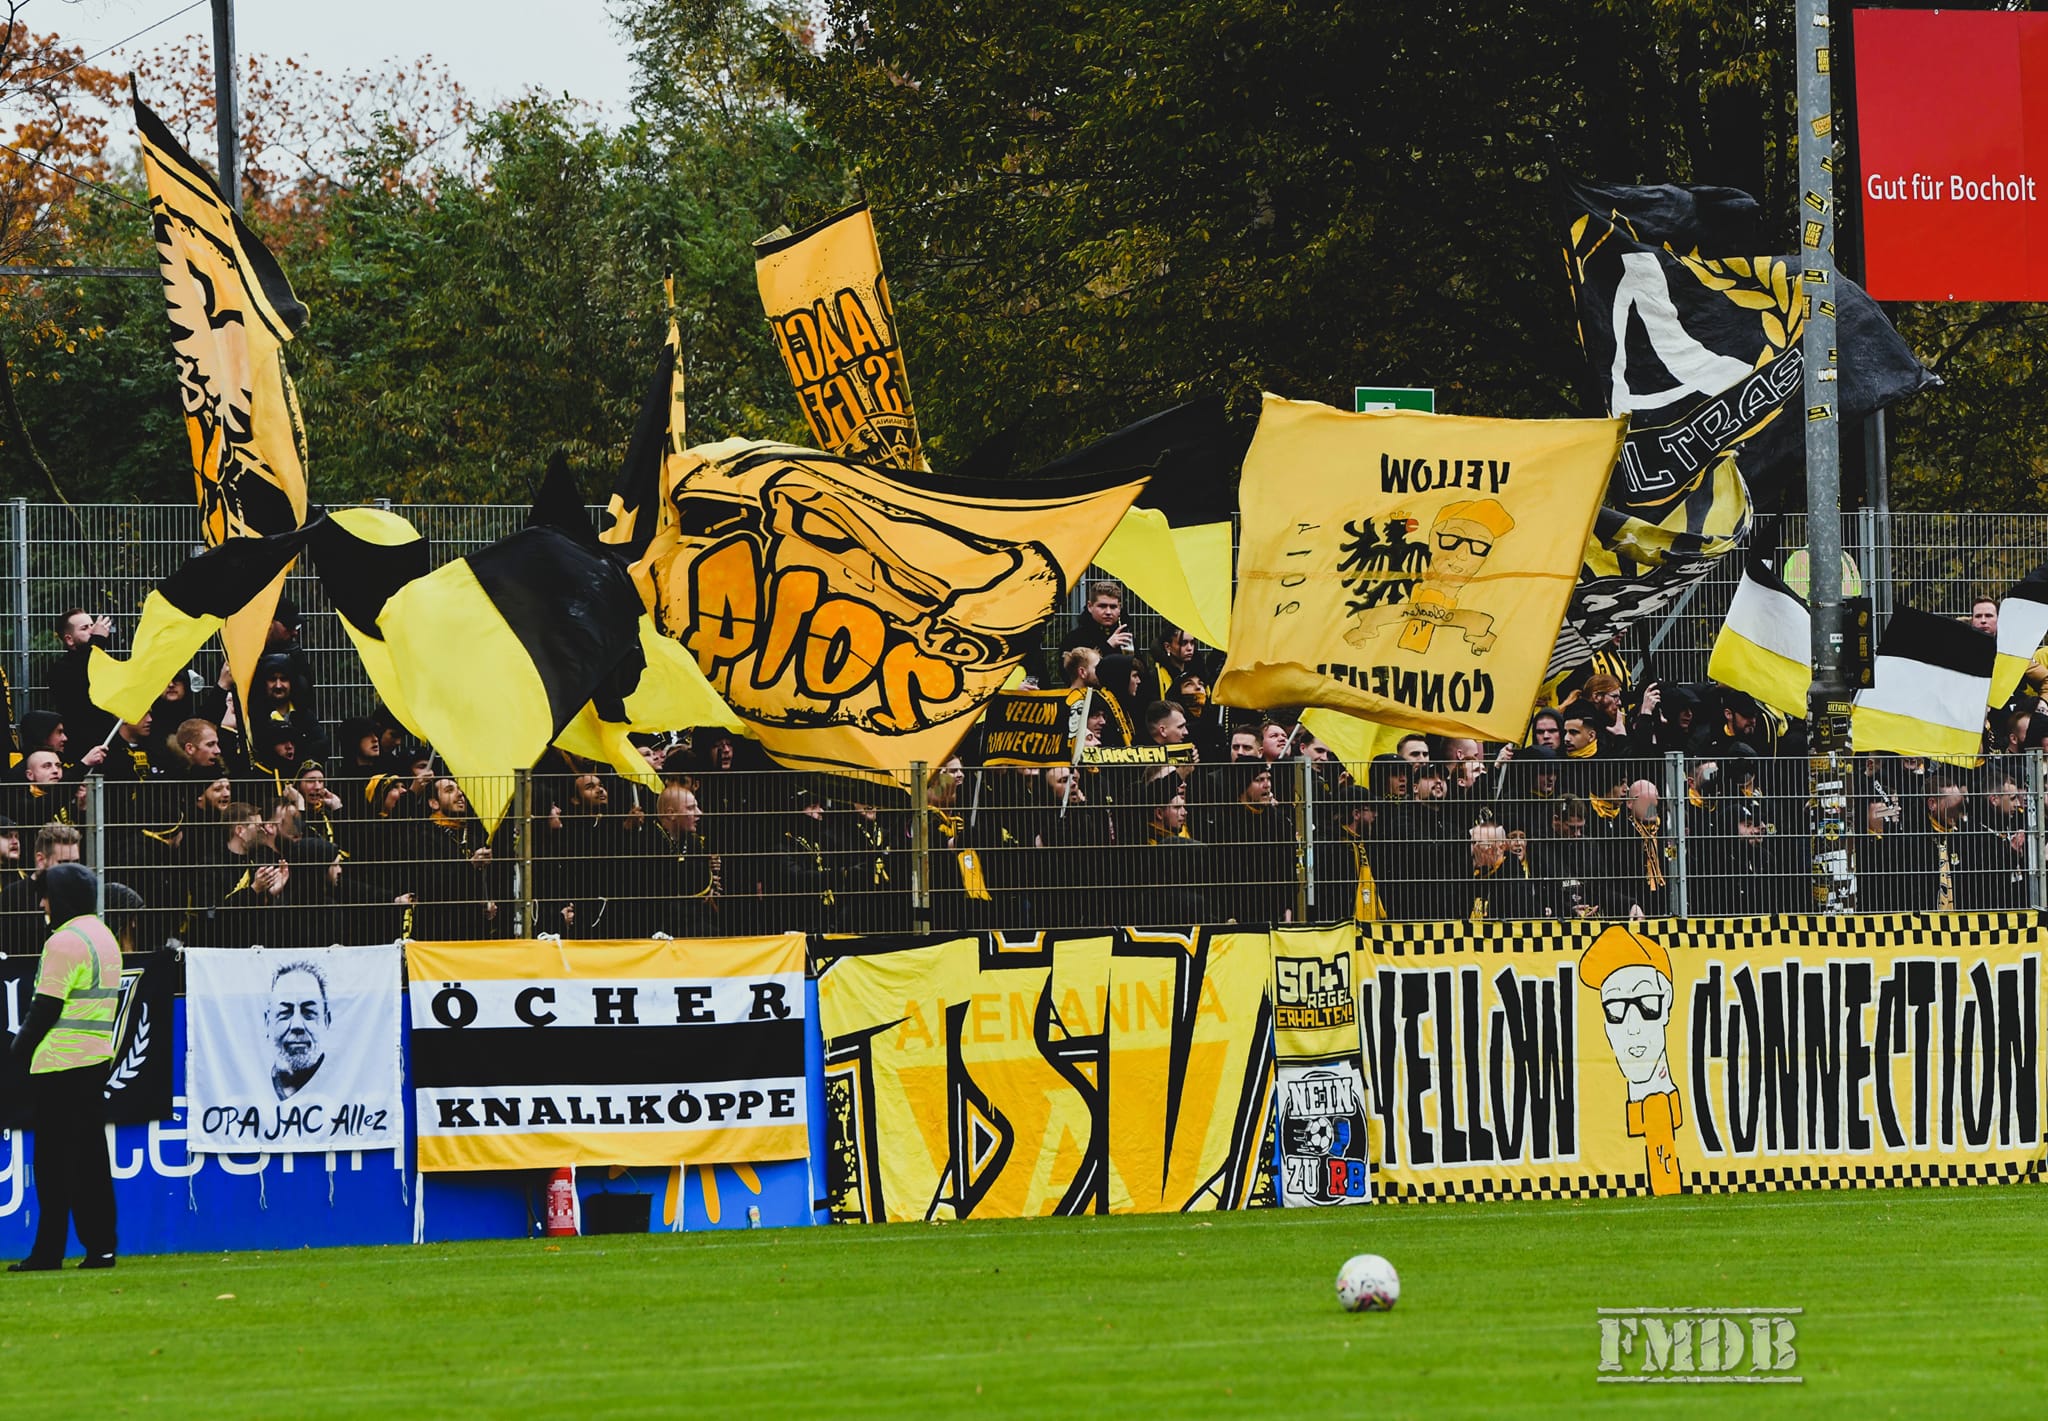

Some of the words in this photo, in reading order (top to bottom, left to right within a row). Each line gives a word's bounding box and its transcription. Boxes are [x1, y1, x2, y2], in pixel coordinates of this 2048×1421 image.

[1867, 174, 1907, 200] Gut
[1912, 173, 1944, 200] für
[1950, 174, 2036, 200] Bocholt
[1005, 701, 1059, 725] YELLOW
[1102, 746, 1166, 763] AACHEN
[1278, 954, 1351, 1004] 50+1
[895, 976, 1228, 1051] ALEMANNA
[1276, 1005, 1355, 1030] ERHALTEN!
[1307, 991, 1352, 1010] REGEL
[1360, 962, 1577, 1167] YELLOW
[1690, 955, 2038, 1155] CONNECTION
[436, 1088, 796, 1128] KNALLKÖPPE
[1289, 1079, 1354, 1117] NEIN
[202, 1105, 260, 1138] OPA
[264, 1104, 323, 1141] JAC
[330, 1103, 388, 1137] Allez
[1287, 1157, 1320, 1195] ZU
[1328, 1160, 1367, 1197] RB
